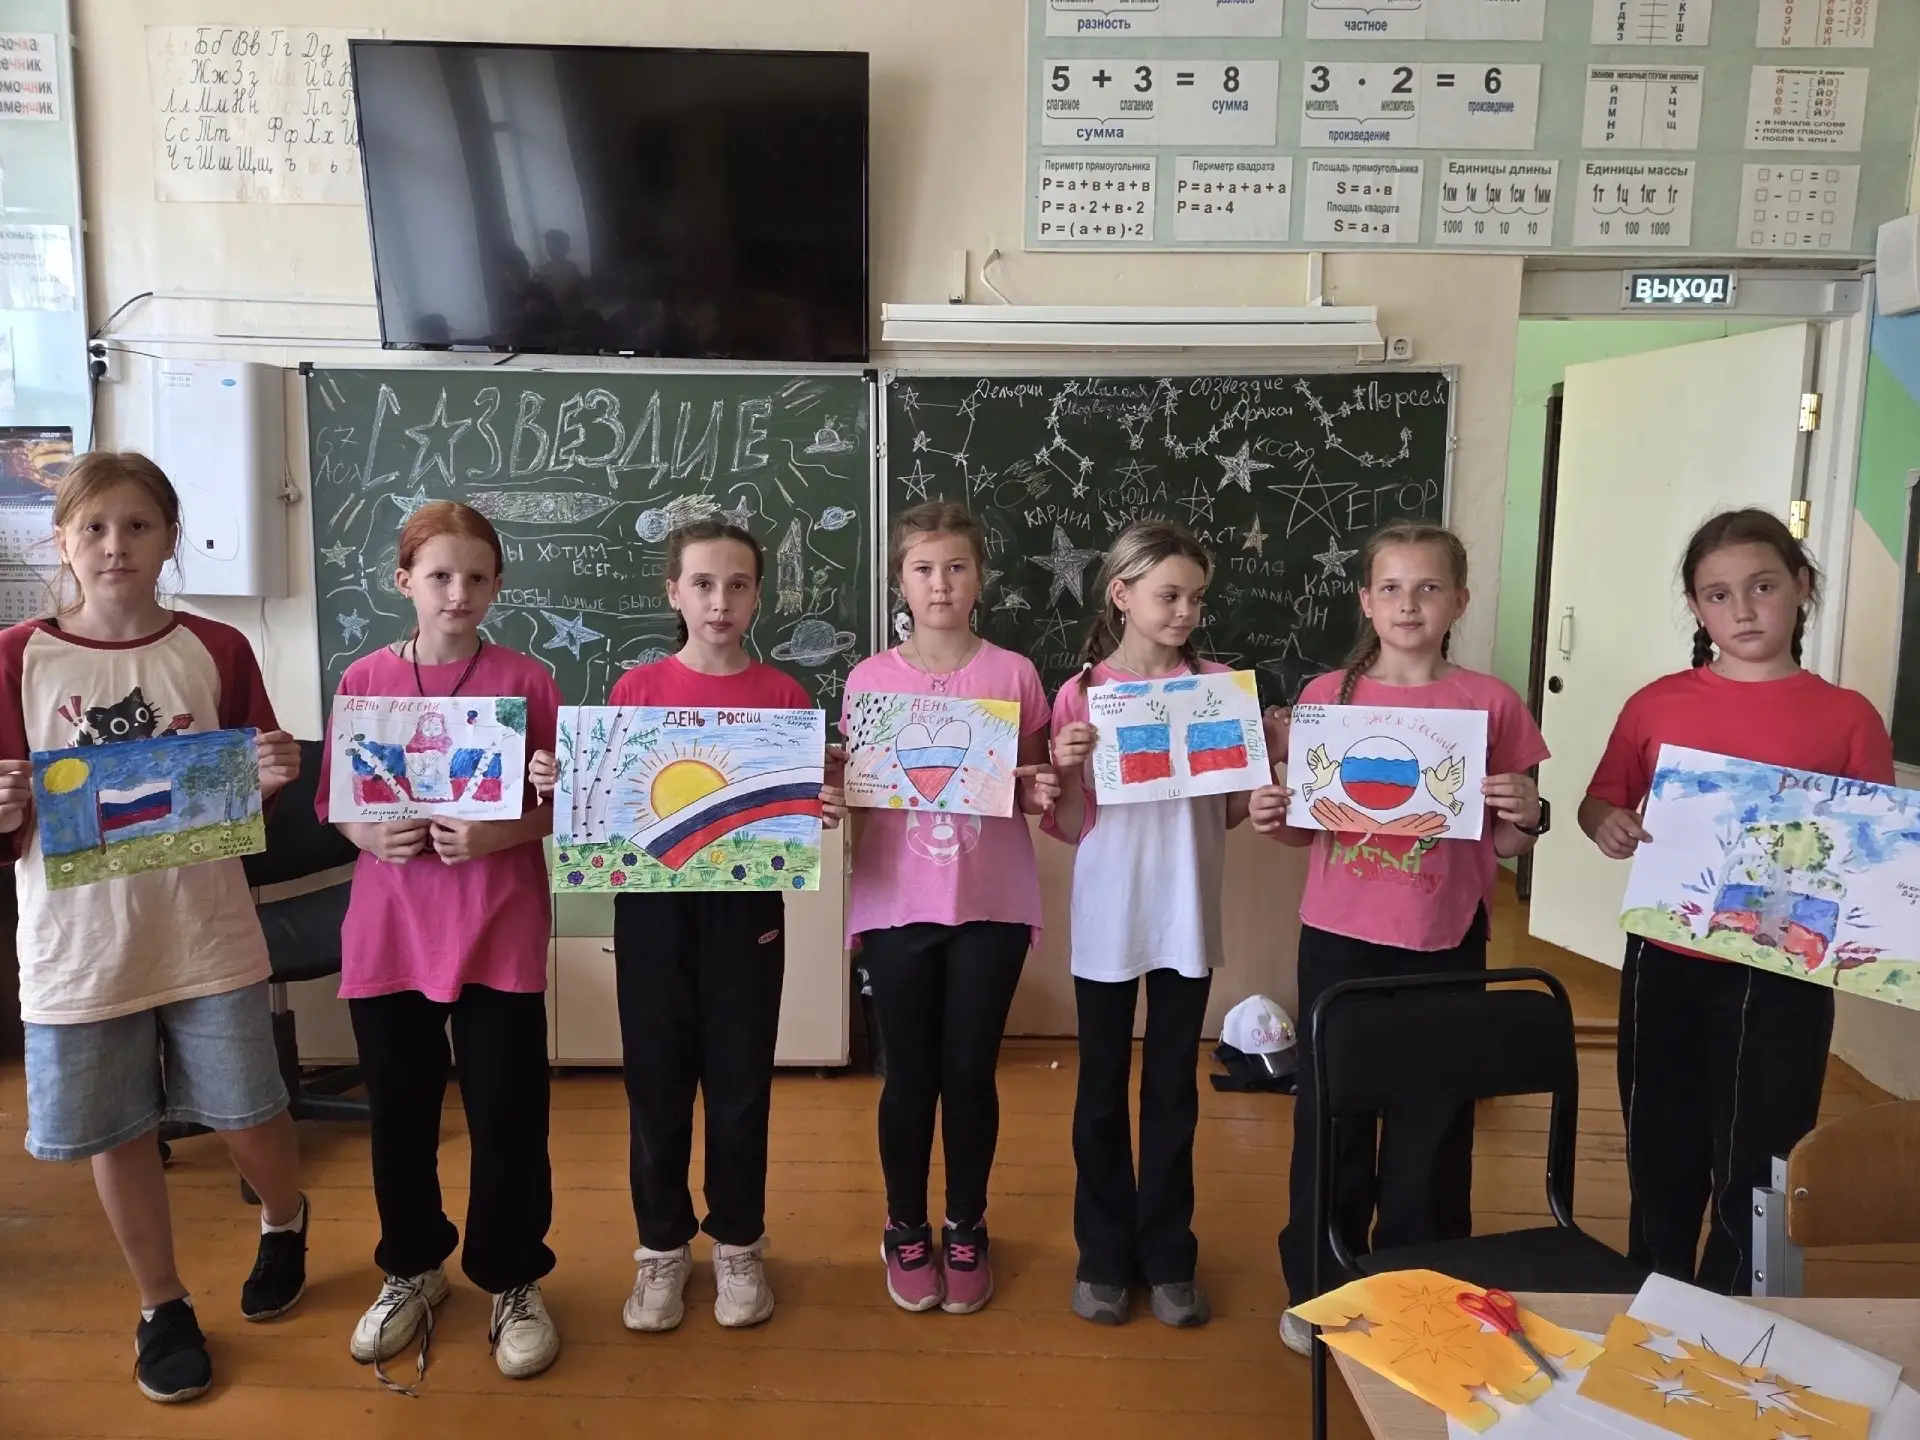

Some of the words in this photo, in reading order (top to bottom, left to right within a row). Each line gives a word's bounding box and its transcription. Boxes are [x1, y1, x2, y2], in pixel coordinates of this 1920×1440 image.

[1077, 18, 1131, 30] разность
[1344, 20, 1388, 31] частное
[1052, 66, 1070, 92] 5
[1134, 66, 1152, 92] 3
[1223, 66, 1240, 93] 8
[1310, 66, 1330, 93] 3
[1391, 66, 1413, 93] 2
[1484, 68, 1502, 94] 6
[1046, 99, 1080, 111] слагаемое
[1120, 100, 1153, 111] слагаемое
[1212, 100, 1249, 114] сумма
[1305, 100, 1339, 111] множитель
[1381, 100, 1415, 111] множитель
[1468, 101, 1514, 115] произведение
[1076, 128, 1124, 141] сумма
[1328, 130, 1390, 143] произведение
[1045, 160, 1084, 174] Периметр
[1085, 161, 1150, 174] прямоугольника
[1193, 160, 1234, 173] Периметр
[1236, 161, 1275, 172] квадрата
[1312, 162, 1350, 173] Площадь
[1352, 163, 1419, 175] прямоугольника
[1449, 162, 1506, 175] Единицы
[1509, 164, 1552, 176] длины
[1586, 163, 1645, 177] Единицы
[1648, 166, 1688, 176] массы
[1443, 183, 1457, 202] 1км
[1467, 183, 1477, 202] 1м
[1486, 183, 1501, 205] 1дм
[1510, 183, 1525, 204] 1см
[1535, 184, 1551, 204] 1мм
[1593, 184, 1605, 203] 1т
[1617, 184, 1629, 206] 1ц
[1641, 184, 1657, 204] 1кг
[1668, 185, 1678, 204] 1г
[1327, 201, 1362, 213] Площадь
[1364, 204, 1400, 215] квадрата
[1443, 220, 1463, 233] 1000
[1474, 221, 1484, 233] 10
[1500, 222, 1510, 234] 10
[1528, 222, 1538, 235] 10
[1600, 221, 1610, 234] 10
[1625, 222, 1640, 234] 100
[1651, 222, 1670, 236] 1000
[1635, 278, 1725, 304] ВЫХОД
[1190, 378, 1284, 411] Созвездие
[1368, 380, 1446, 418] Персей
[1024, 505, 1091, 530] КАРИНА
[911, 699, 948, 712] ДЕНЬ
[663, 711, 706, 728] ДЕНЬ
